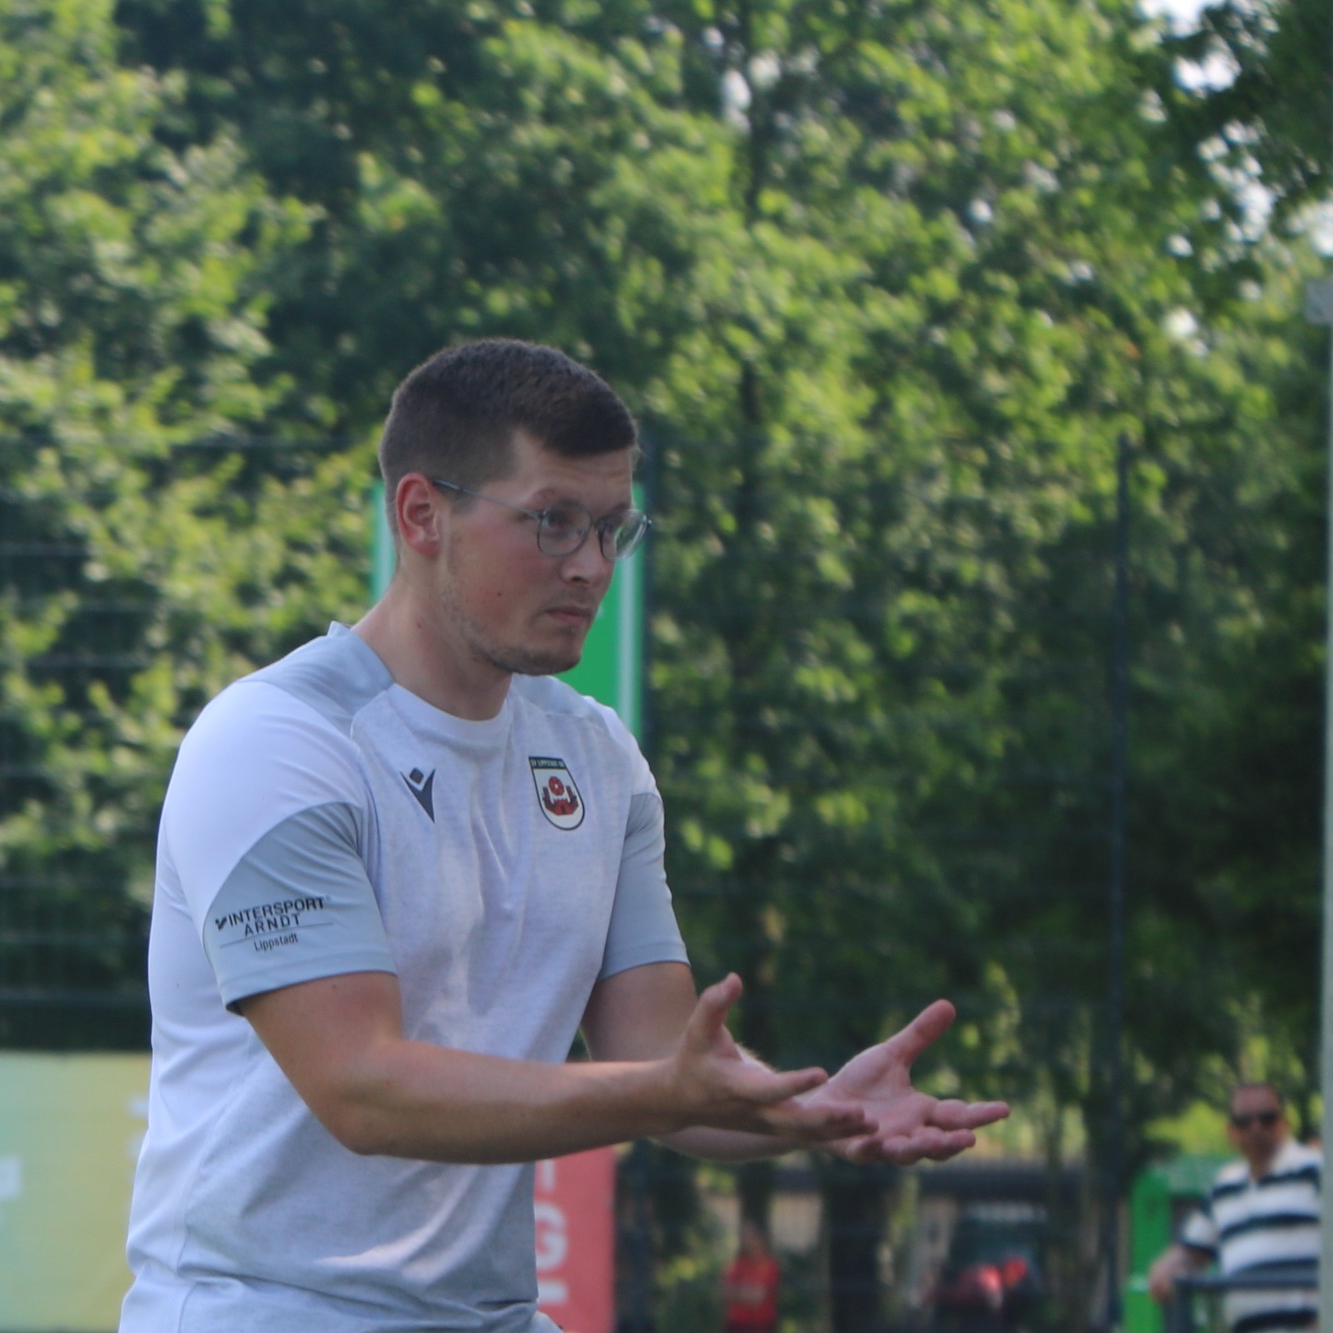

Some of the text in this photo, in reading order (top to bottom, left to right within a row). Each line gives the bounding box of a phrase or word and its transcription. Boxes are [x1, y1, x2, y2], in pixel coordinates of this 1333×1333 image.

[227, 897, 326, 927] INTERSPORT
[244, 913, 301, 938] ARNDT
[253, 932, 299, 953] Lippstadt
